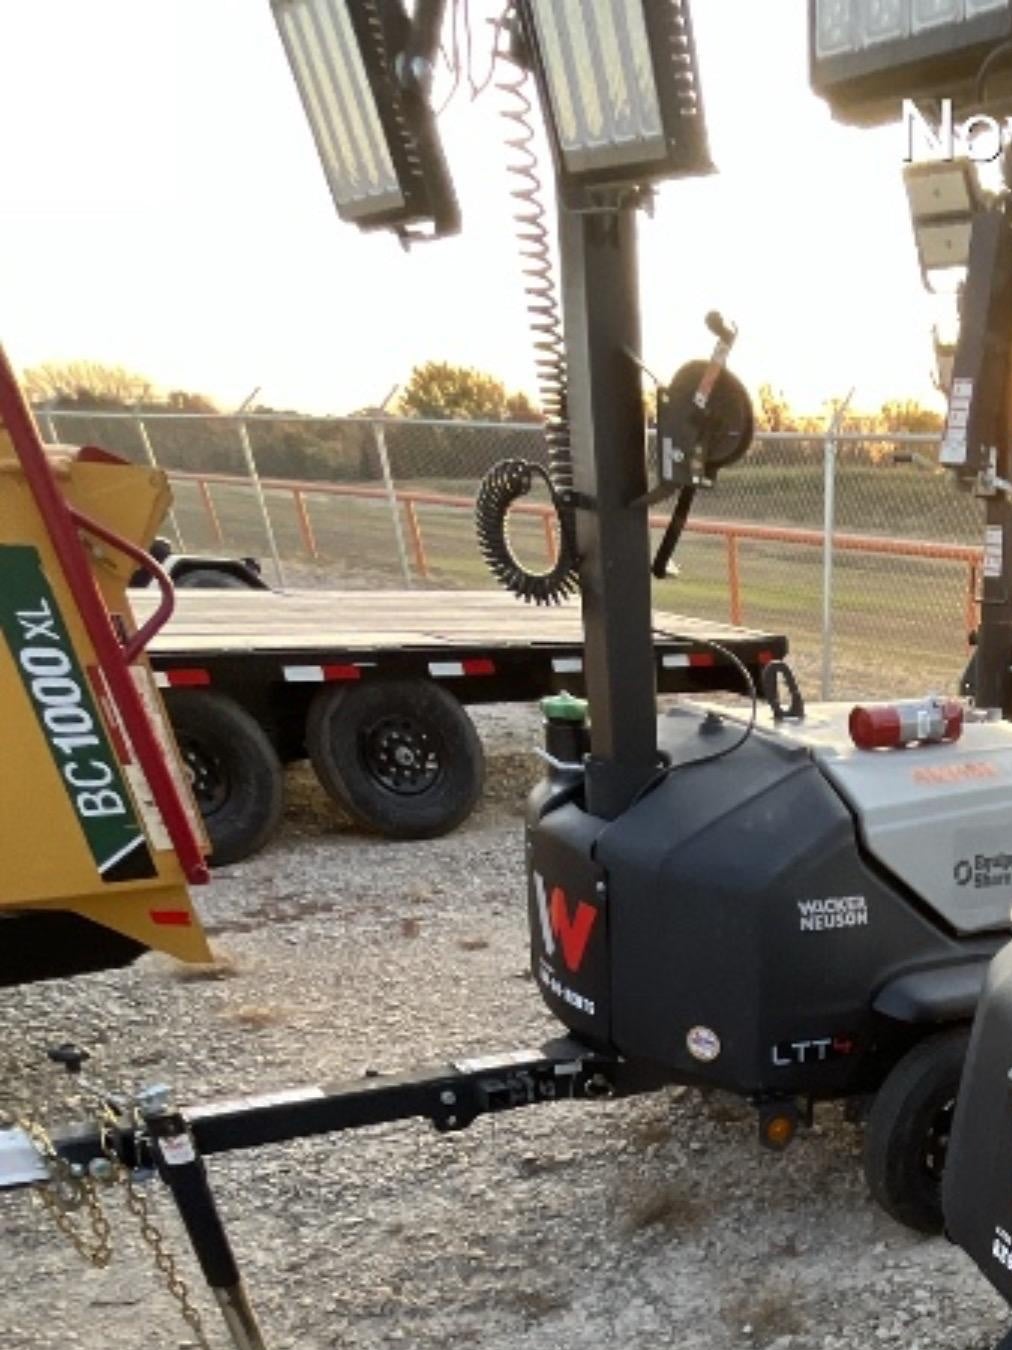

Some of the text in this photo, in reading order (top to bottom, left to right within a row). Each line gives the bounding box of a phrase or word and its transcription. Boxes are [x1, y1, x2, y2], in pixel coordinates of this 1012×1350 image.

[14, 596, 61, 641] XL
[18, 645, 100, 755] 1000
[63, 759, 128, 818] BC
